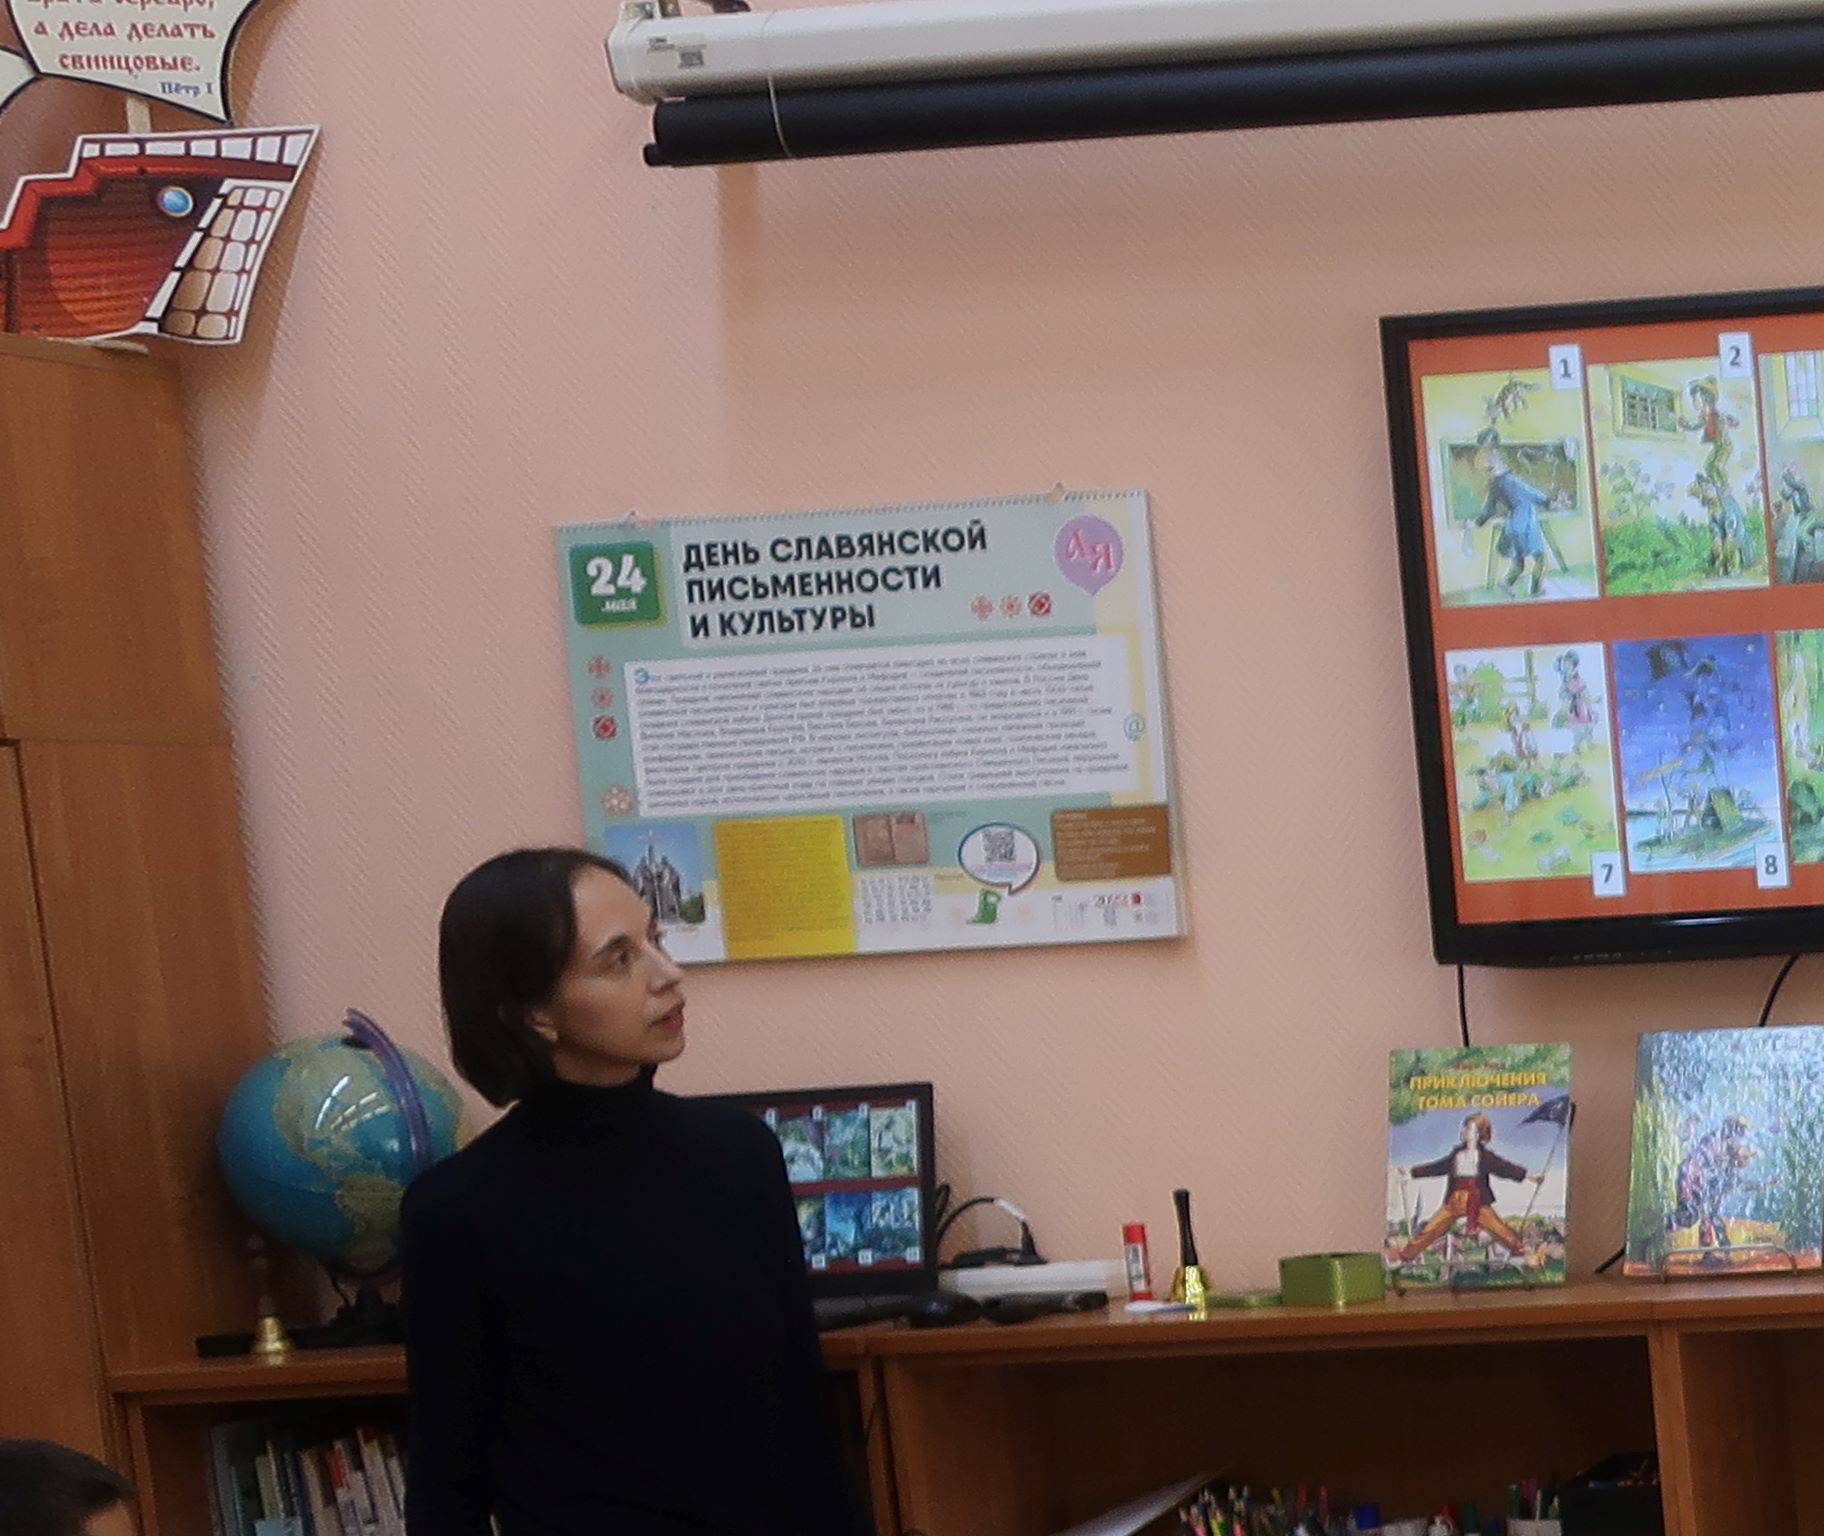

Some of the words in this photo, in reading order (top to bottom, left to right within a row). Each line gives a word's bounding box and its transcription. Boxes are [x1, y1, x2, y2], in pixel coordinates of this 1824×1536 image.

[1729, 345, 1741, 368] 2
[1560, 358, 1572, 379] 1
[683, 541, 760, 573] ДЕНЬ
[770, 519, 988, 562] СЛАВЯНСКОЙ
[586, 555, 648, 596] 24
[686, 565, 942, 604] ПИСЬМЕННОСТИ
[690, 614, 709, 639] И
[719, 604, 876, 638] КУЛЬТУРЫ
[1600, 863, 1614, 884] 7
[1764, 854, 1779, 876] 8
[1419, 1095, 1466, 1109] ТОМА
